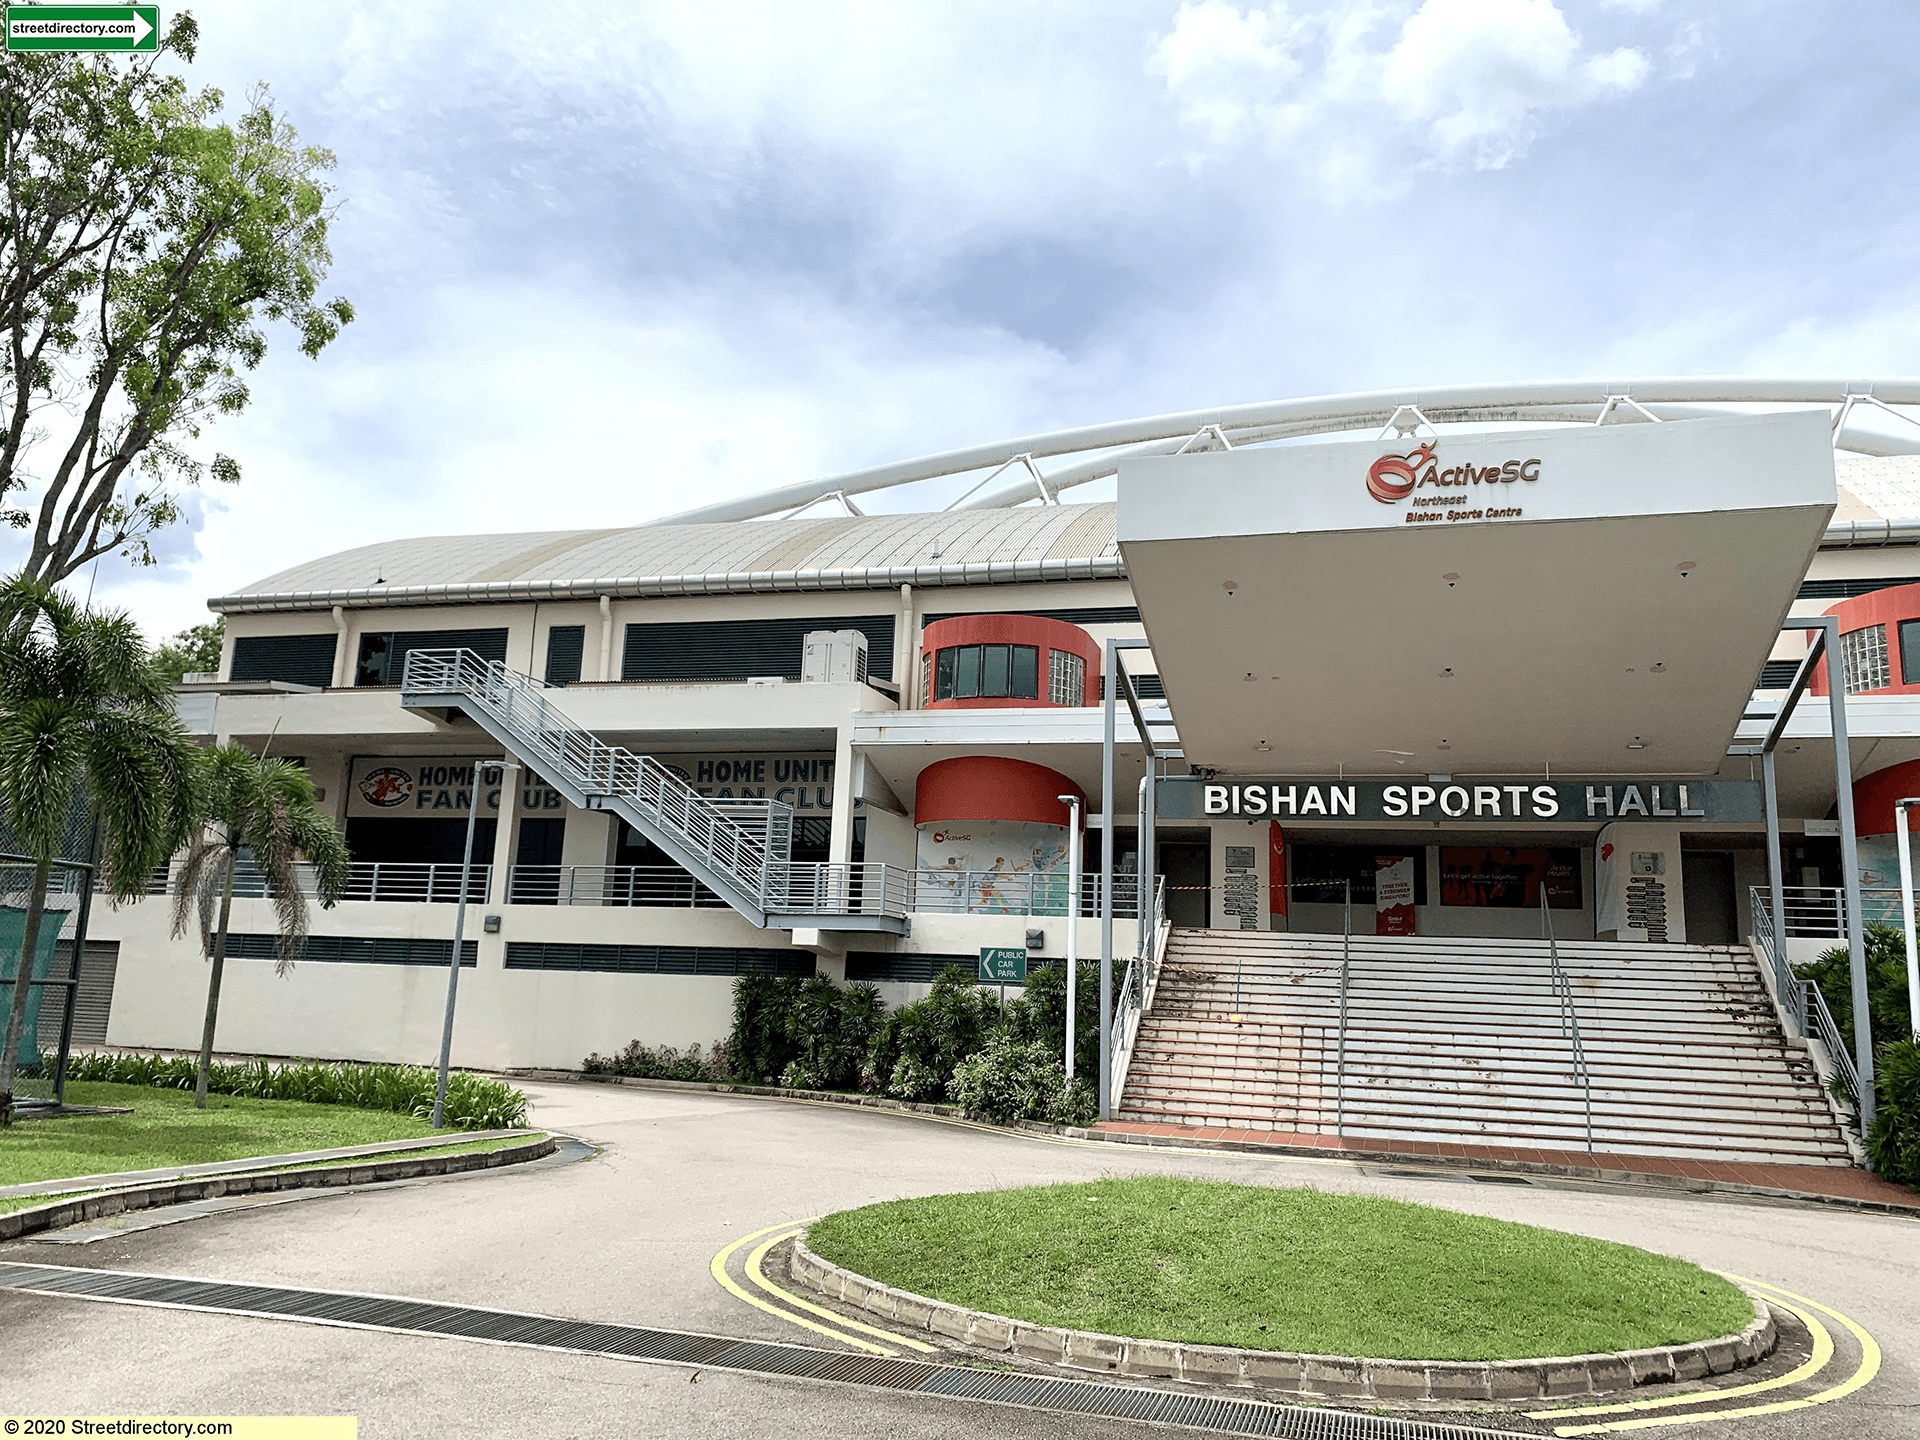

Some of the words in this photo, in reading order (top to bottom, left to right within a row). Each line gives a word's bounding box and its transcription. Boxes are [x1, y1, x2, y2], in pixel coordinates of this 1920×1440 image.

[1417, 459, 1542, 488] ActiveSG
[1412, 494, 1468, 507] Northeast
[1405, 512, 1443, 523] Bishan
[1446, 509, 1483, 522] Sports
[1485, 507, 1523, 518] Centre
[697, 760, 765, 783] HOME
[774, 760, 834, 782] UNIT
[416, 789, 473, 810] FAN
[487, 788, 561, 810] CUB
[1204, 785, 1356, 815] BISHAN
[1382, 785, 1559, 816] SPORTS
[1586, 785, 1705, 816] HALL
[997, 951, 1024, 959] PUBLIC
